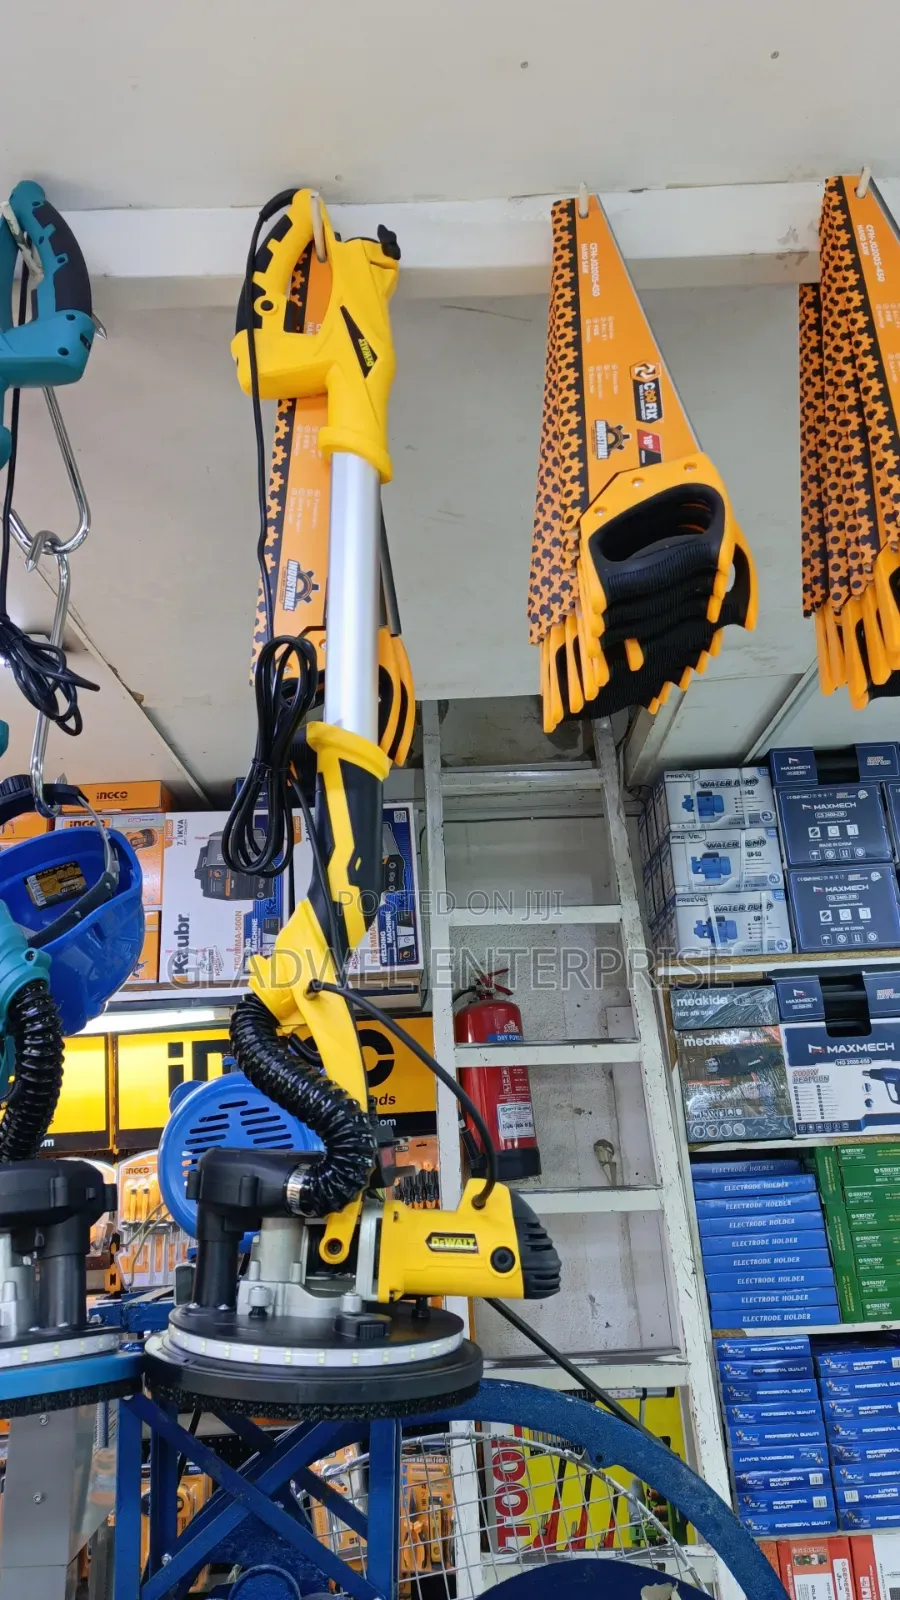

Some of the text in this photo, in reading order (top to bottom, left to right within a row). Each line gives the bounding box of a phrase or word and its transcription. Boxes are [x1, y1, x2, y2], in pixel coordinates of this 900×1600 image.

[596, 420, 608, 459] INDUSTRIAL
[284, 560, 298, 611] INDUSTRIAL
[700, 779, 732, 788] WATER
[813, 802, 856, 810] MAXMECH
[705, 841, 738, 849] WATER
[825, 884, 869, 893] MAXMECH
[713, 904, 746, 912] WATER
[826, 1042, 895, 1054] MAXMECH
[712, 1165, 747, 1173] ELECTRODE
[724, 1183, 761, 1192] ELECTRODE
[725, 1201, 762, 1210] ELECTRODE
[729, 1218, 795, 1228] ELECTRODE HOLDER
[732, 1239, 769, 1247] ELECTRODE
[733, 1258, 771, 1266] ELECTRODE
[741, 1295, 779, 1303] ELECTRODE
